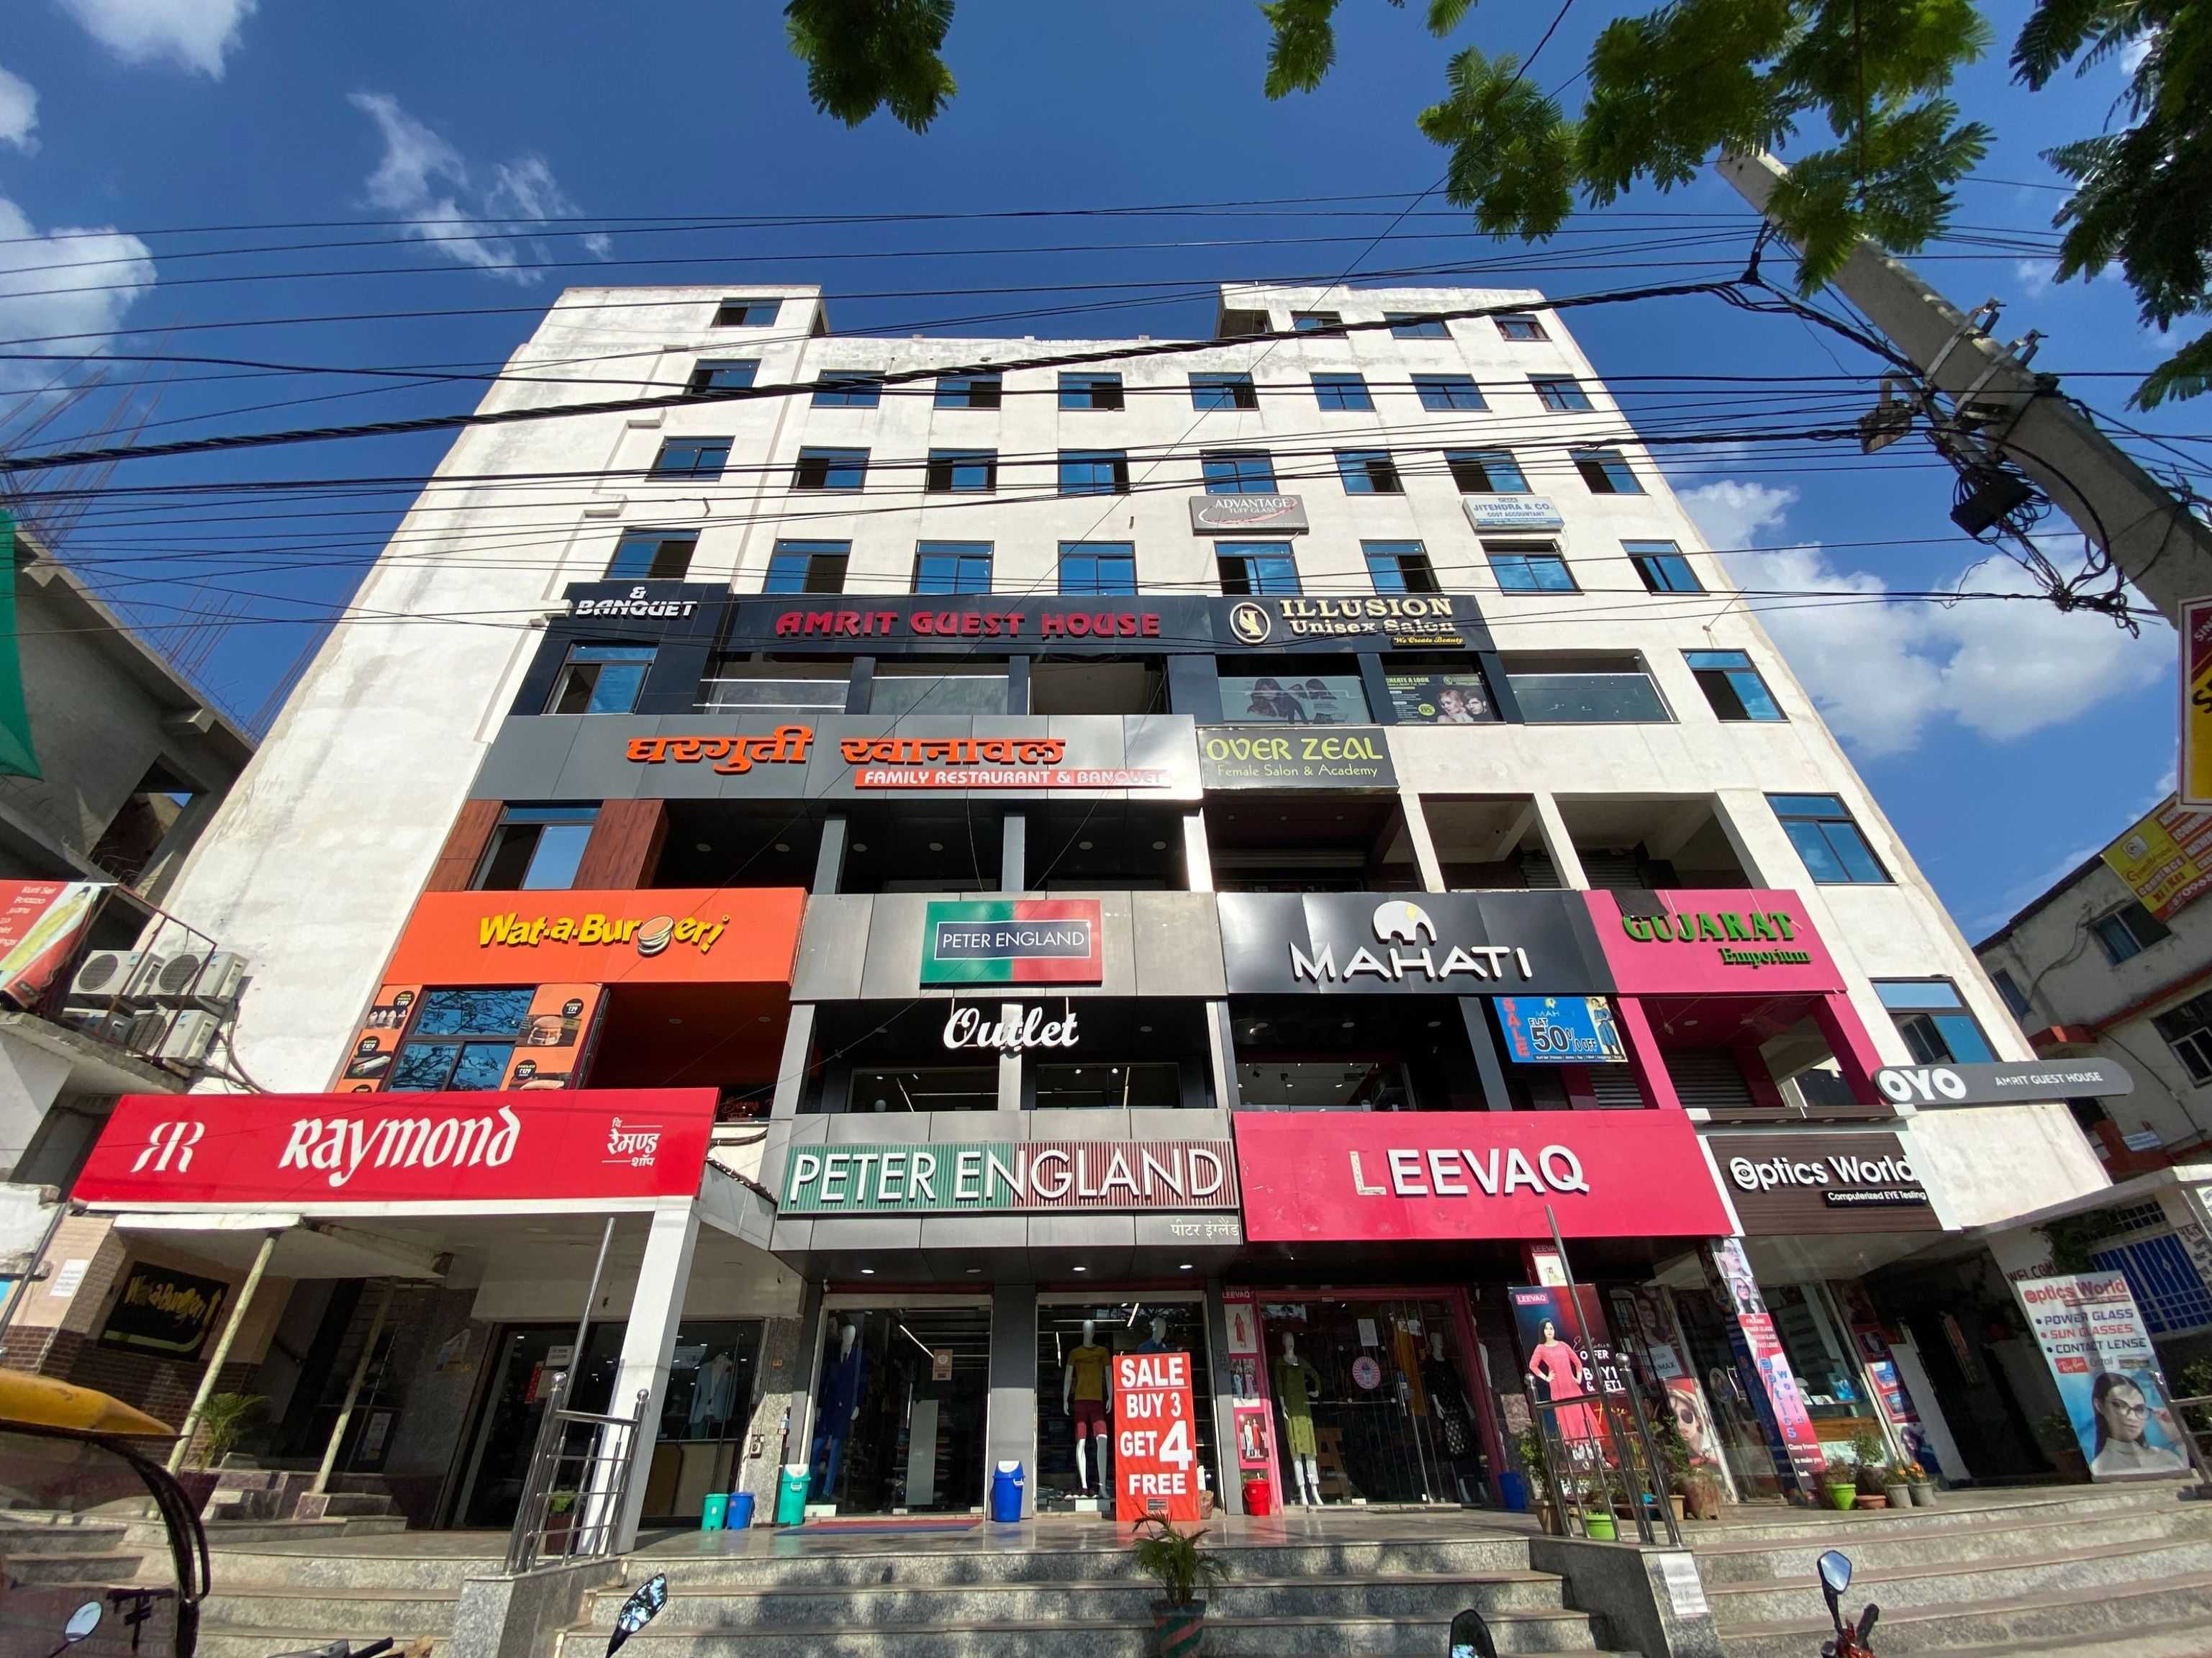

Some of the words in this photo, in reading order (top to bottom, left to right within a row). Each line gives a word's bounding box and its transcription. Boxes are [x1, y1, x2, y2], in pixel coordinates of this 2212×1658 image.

[1215, 498, 1289, 508] ADVANTAGE
[629, 586, 647, 599] &
[576, 599, 698, 617] BANQUET
[1280, 598, 1454, 617] ILLUSION
[776, 611, 898, 638] AMRIT
[910, 612, 1025, 638] GUEST
[1041, 612, 1161, 639] HOUSE
[1289, 619, 1378, 635] Unisex
[1383, 618, 1456, 633] Salon
[1433, 636, 1464, 645] Beauty
[626, 725, 814, 774] घरगुती
[1206, 737, 1292, 761] OVER
[1300, 737, 1383, 761] ZEAL
[864, 771, 930, 784] FAMILY
[934, 770, 1050, 784] RESTAURANT
[1056, 771, 1072, 784] &
[1076, 770, 1163, 784] BANQUET
[1218, 764, 1259, 777] Female
[1264, 764, 1298, 776] Salon
[1304, 765, 1313, 776] &
[1318, 764, 1378, 778] Academy
[1623, 912, 1795, 941] GUJARAT
[943, 933, 991, 948] PETER
[996, 931, 1084, 948] ENGLAND
[1290, 941, 1533, 982] MAHATI
[1718, 948, 1811, 969] Emporium
[943, 1007, 1079, 1049] Outlet
[1528, 1018, 1549, 1026] FLAT
[1531, 1025, 1582, 1053] 50%
[1582, 1037, 1597, 1053] OFF
[1879, 1067, 1967, 1102] OYO
[1995, 1075, 2028, 1087] AMRIT
[2030, 1073, 2067, 1085] GUEST
[2068, 1072, 2103, 1083] HOUSE
[278, 1105, 522, 1187] Raymond
[790, 1151, 936, 1205] PETER
[956, 1147, 1223, 1200] ENGLAND
[1349, 1144, 1590, 1196] LEEVAQ
[1729, 1156, 1829, 1190] Optics
[1826, 1155, 1918, 1184] World
[1828, 1190, 1883, 1201] Computerized
[1884, 1191, 1900, 1200] EYE
[1900, 1190, 1927, 1200] Testing
[1170, 1218, 1201, 1236] पीटर
[1517, 1295, 1547, 1303] LEEVAQ
[2023, 1282, 2076, 1304] Optics
[2075, 1277, 2126, 1299] World
[2044, 1312, 2088, 1326] POWER
[2092, 1308, 2134, 1321] GLASS
[2050, 1327, 2075, 1340] SUN
[2079, 1323, 2134, 1337] GLASSES
[1579, 1349, 1610, 1361] OFER
[2055, 1340, 2105, 1354] CONTACT
[2107, 1337, 2147, 1350] LENSE
[1120, 1356, 1185, 1388] SALE
[1586, 1380, 1596, 1392] &
[1603, 1379, 1623, 1391] ET1
[1126, 1392, 1164, 1418] BUY
[1171, 1392, 1182, 1417] 3
[1120, 1430, 1158, 1457] GET
[1159, 1420, 1193, 1471] 4
[1128, 1473, 1187, 1496] FREE
